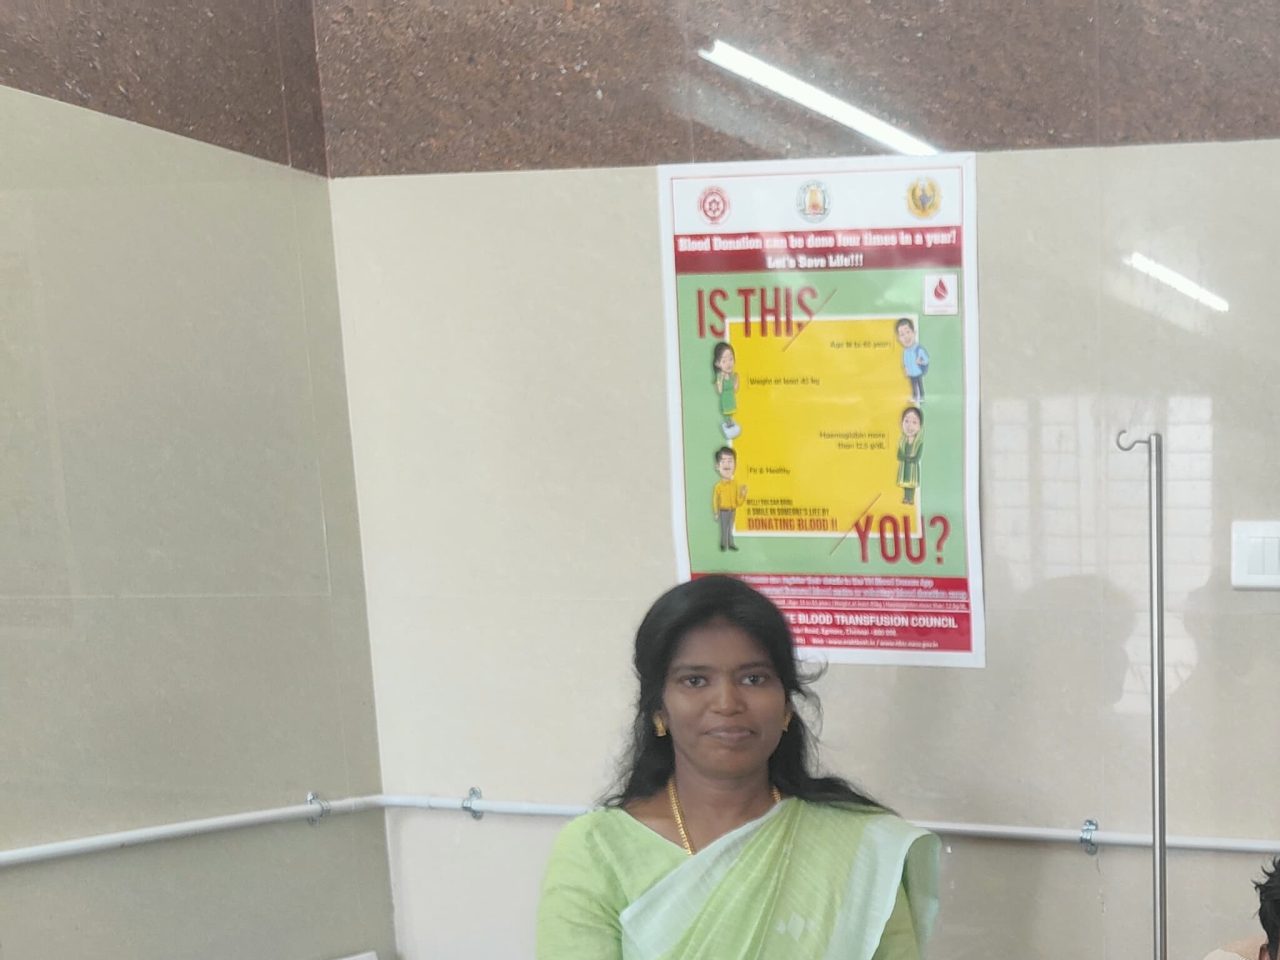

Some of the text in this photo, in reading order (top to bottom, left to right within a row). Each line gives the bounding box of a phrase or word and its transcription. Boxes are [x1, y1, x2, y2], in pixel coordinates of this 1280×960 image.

[712, 235, 762, 250] Donation
[697, 284, 819, 340] IS THIS
[748, 518, 795, 531] DONATING
[797, 518, 829, 531] BLOOD
[854, 512, 952, 565] YOU?
[799, 614, 833, 625] BLOOD
[834, 615, 909, 627] TRANSFUSION
[911, 617, 958, 629] COUNCIL
